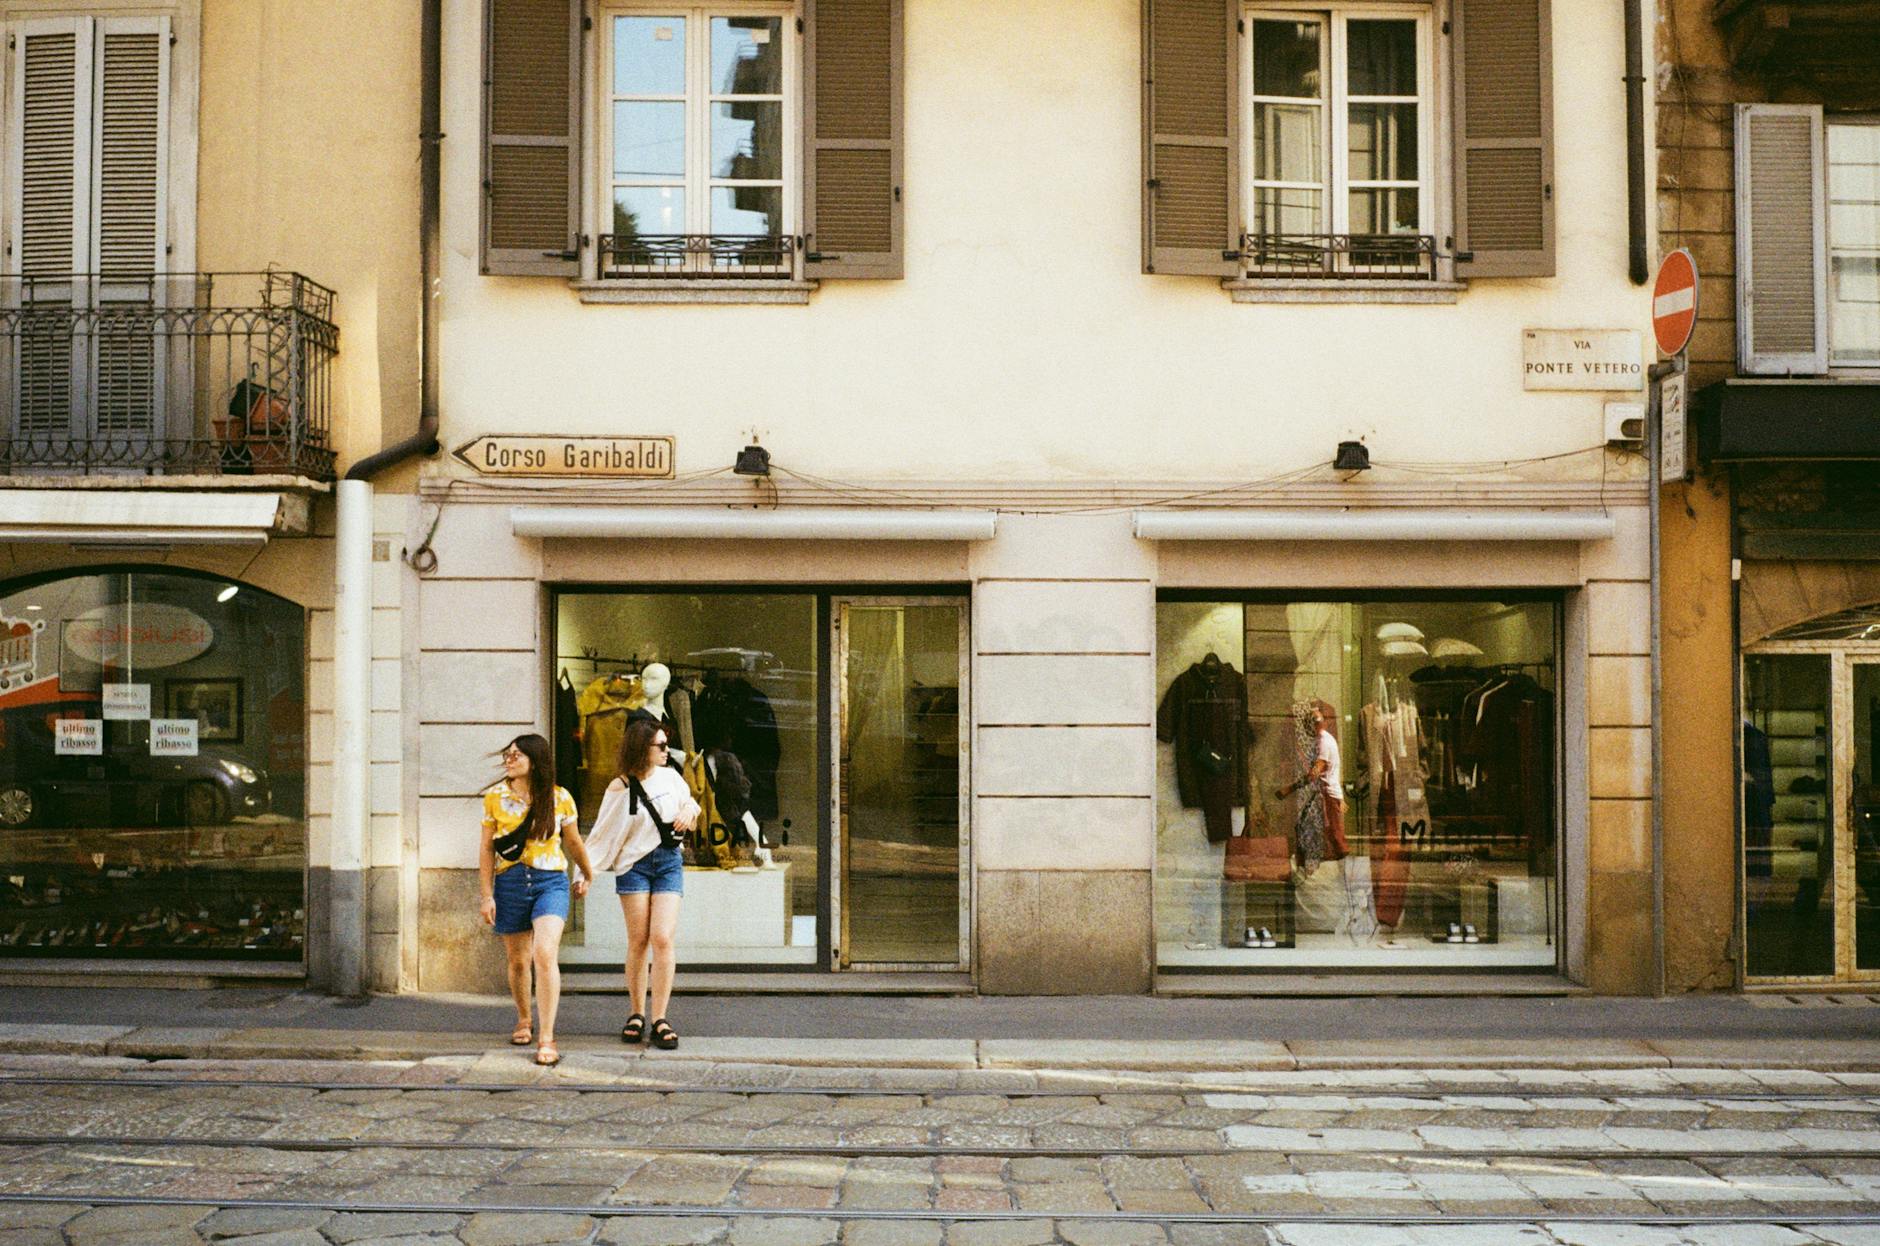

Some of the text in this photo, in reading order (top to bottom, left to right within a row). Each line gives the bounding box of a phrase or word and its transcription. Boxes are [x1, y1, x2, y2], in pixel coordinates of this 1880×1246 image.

[1574, 341, 1591, 350] VIA
[1526, 363, 1641, 374] PONTE VETERO
[485, 442, 663, 469] Corso Garibaldi
[62, 724, 96, 735] ultimo
[157, 724, 190, 735] ultimo
[61, 739, 97, 749] ribasso
[155, 739, 192, 750] ribasso
